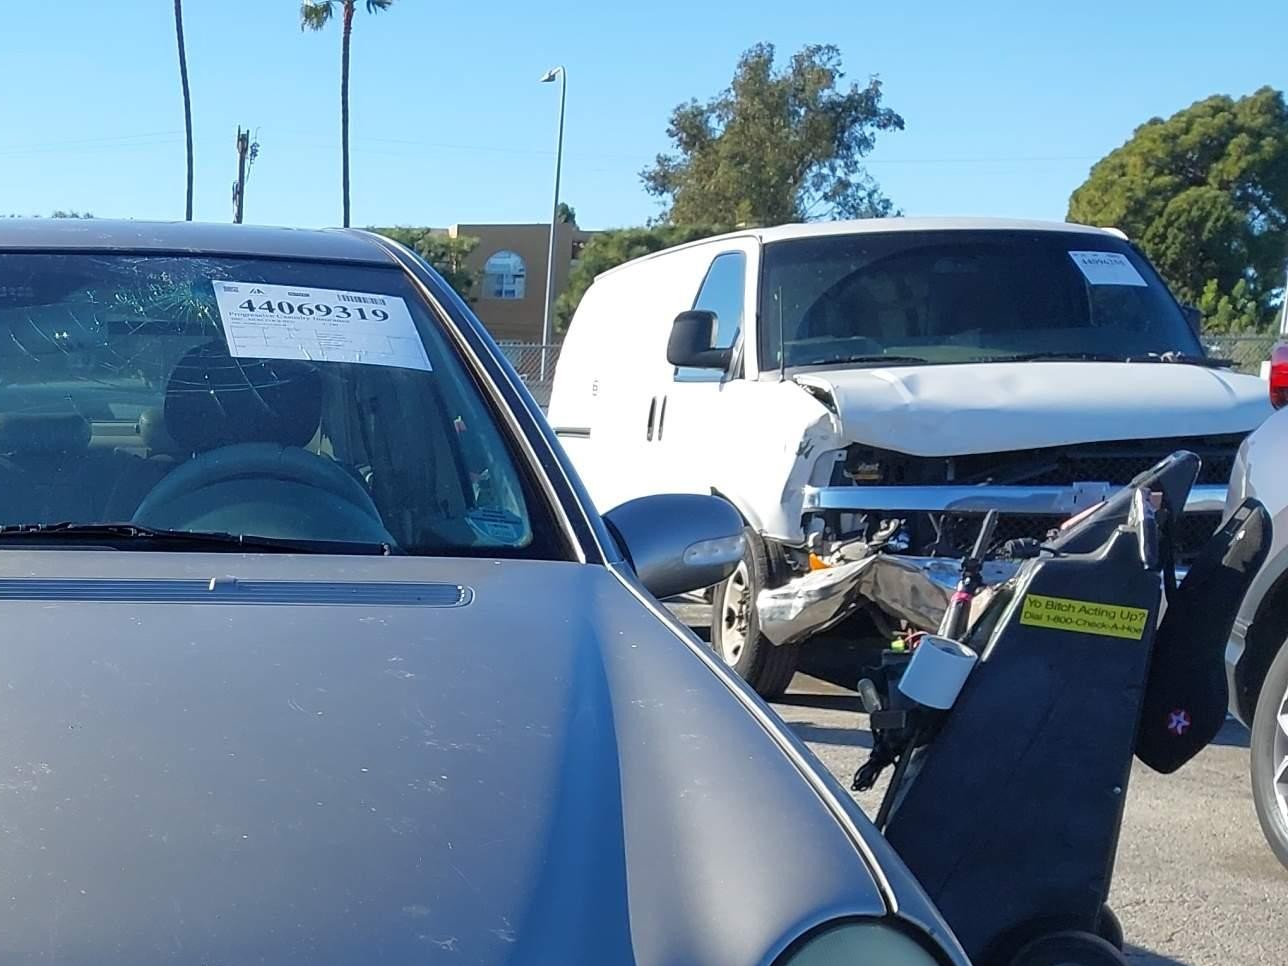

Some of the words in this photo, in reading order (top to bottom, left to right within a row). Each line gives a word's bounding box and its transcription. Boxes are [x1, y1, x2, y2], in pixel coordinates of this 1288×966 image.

[238, 299, 390, 322] 44069319
[1023, 610, 1043, 621] Dial
[1027, 598, 1042, 609] Yo
[1045, 600, 1076, 613] Bitch
[1078, 605, 1117, 620] Acting
[1120, 609, 1146, 622] Up?
